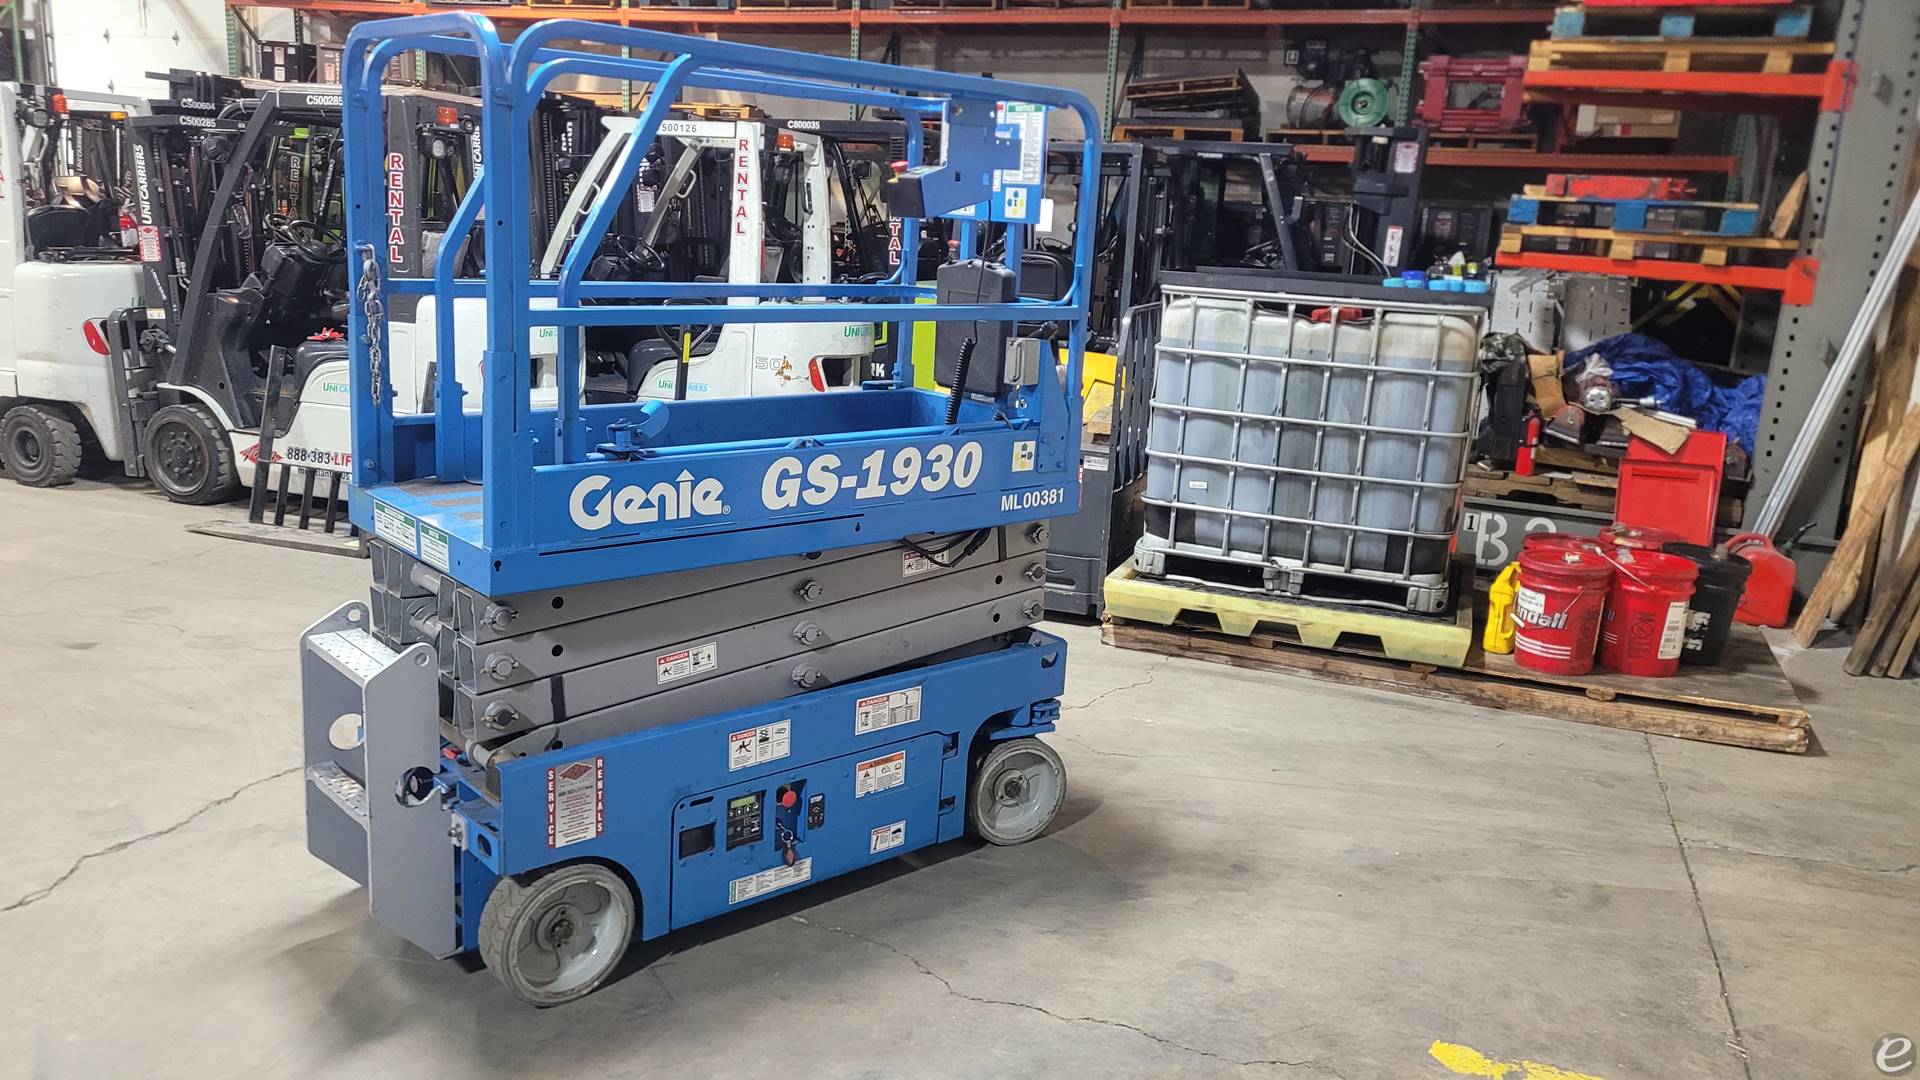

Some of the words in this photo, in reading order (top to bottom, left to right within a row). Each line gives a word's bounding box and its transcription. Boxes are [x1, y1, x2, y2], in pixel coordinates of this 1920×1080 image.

[179, 116, 216, 127] C500285
[662, 123, 697, 133] 500126
[787, 120, 820, 130] C800035
[289, 156, 300, 219] RENTA
[389, 152, 404, 263] RENTAL
[735, 138, 748, 235] RENTAL
[761, 441, 983, 511] GS-1930
[1000, 487, 1064, 512] ML00381
[547, 769, 555, 846] SERVICE
[596, 758, 604, 833] RENTALS
[810, 795, 823, 804] STOP
